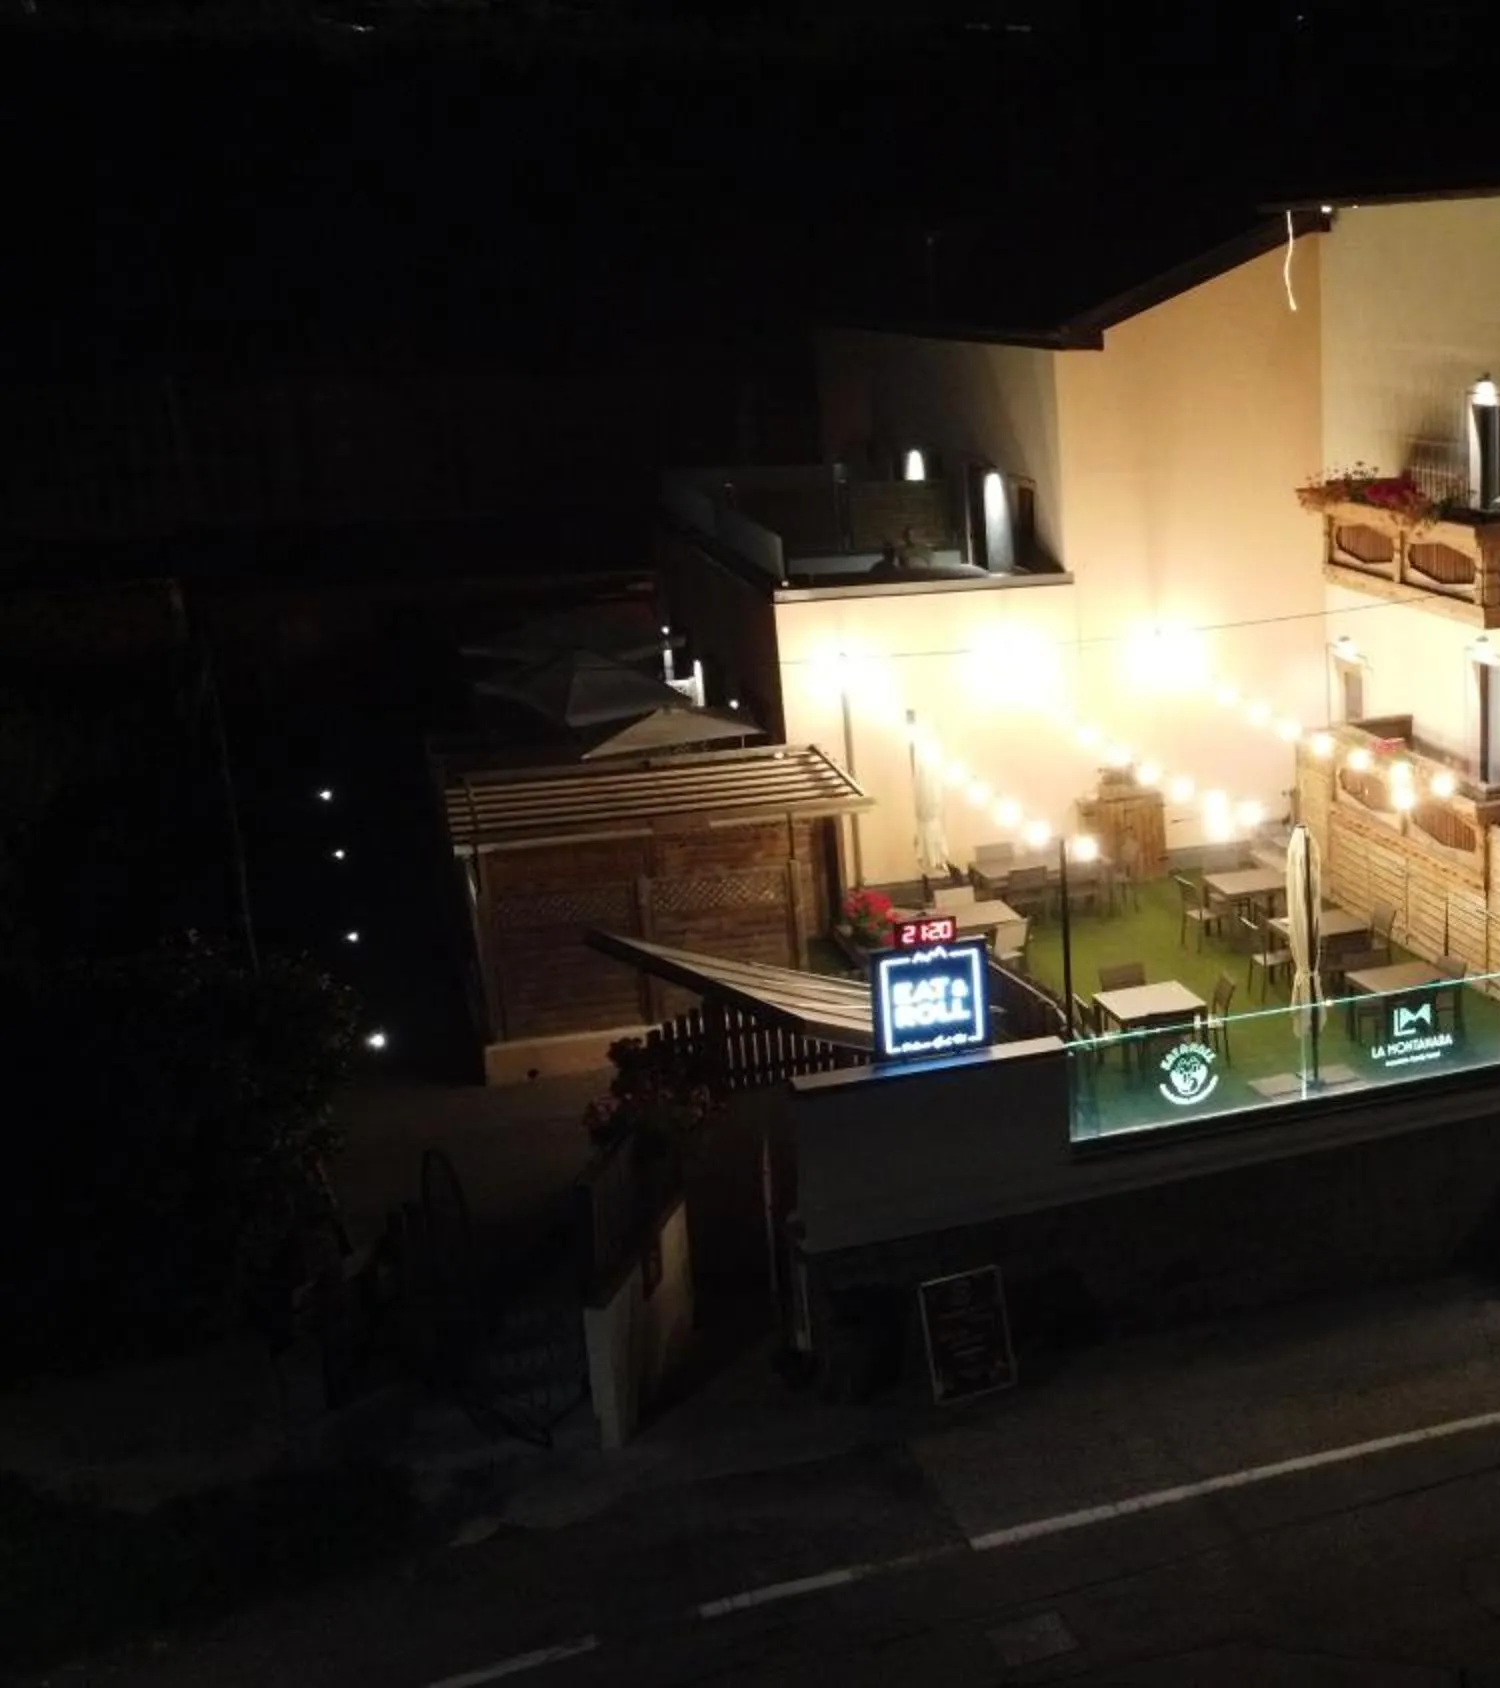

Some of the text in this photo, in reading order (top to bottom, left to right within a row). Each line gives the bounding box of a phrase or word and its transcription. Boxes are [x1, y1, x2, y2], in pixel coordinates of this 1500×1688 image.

[893, 977, 950, 1004] EAT
[895, 998, 971, 1028] ROLL
[1371, 1045, 1386, 1059] LA
[1387, 1033, 1453, 1056] MONTANARA
